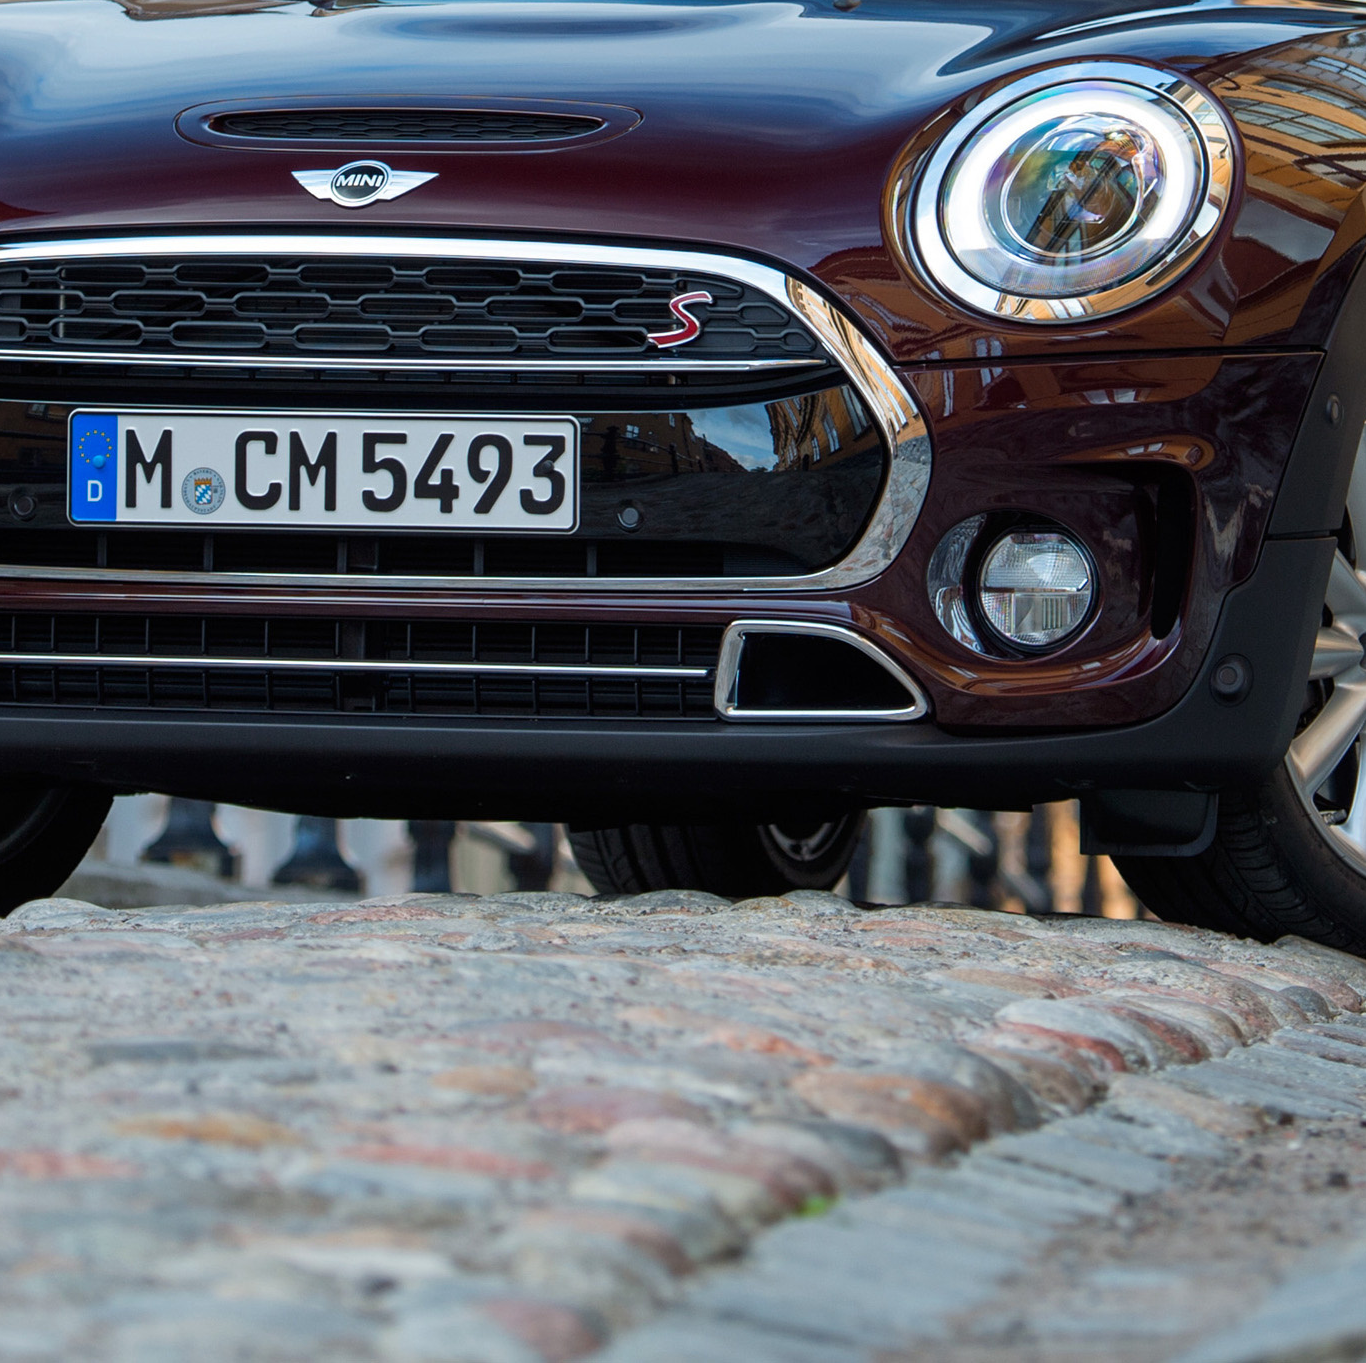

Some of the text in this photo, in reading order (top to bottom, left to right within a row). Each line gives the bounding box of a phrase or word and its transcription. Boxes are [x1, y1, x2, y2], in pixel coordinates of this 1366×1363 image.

[336, 174, 384, 187] MINI
[647, 291, 712, 348] S
[87, 480, 103, 502] D
[125, 429, 173, 509] M
[235, 431, 337, 512] CM
[361, 432, 566, 515] 5493
